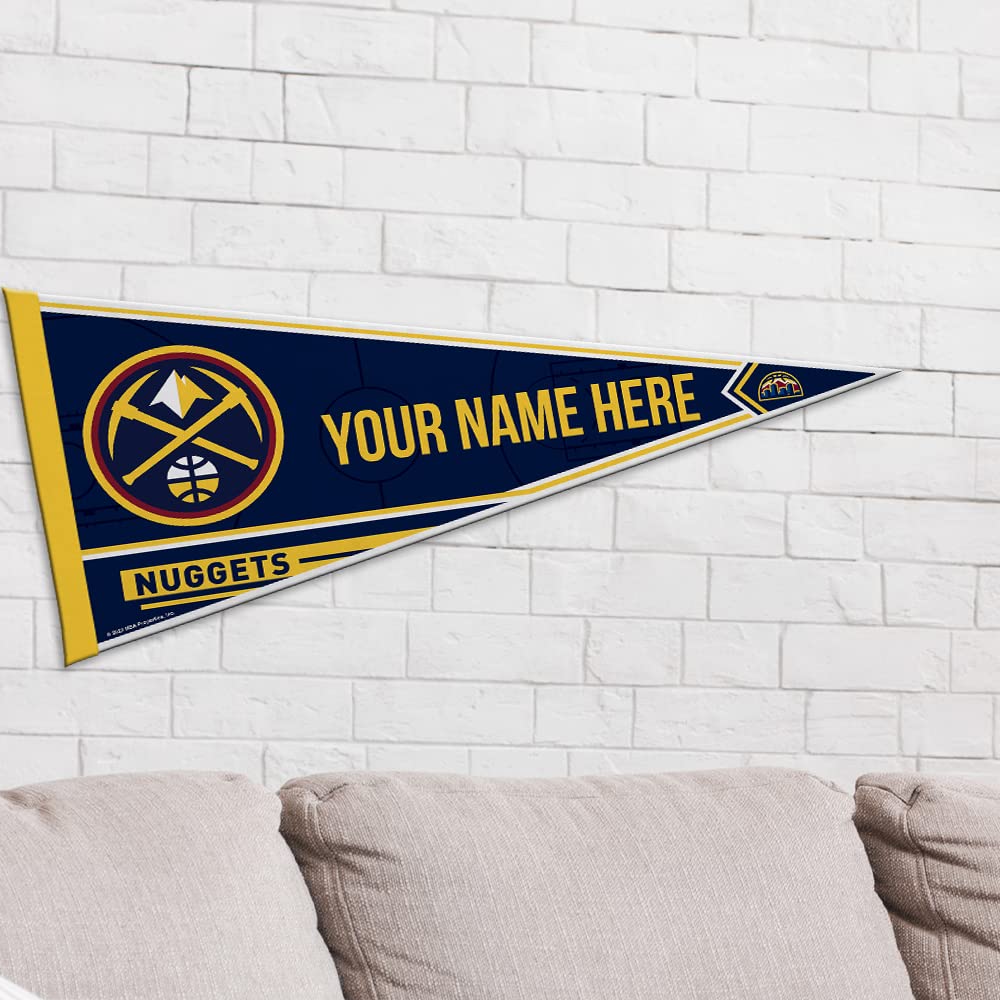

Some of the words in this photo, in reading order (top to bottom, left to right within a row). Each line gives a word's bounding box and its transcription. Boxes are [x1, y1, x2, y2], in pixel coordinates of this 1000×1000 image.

[321, 403, 447, 465] YOUR
[455, 386, 584, 449] NAME
[591, 373, 701, 433] HERE
[134, 553, 290, 596] NUGGETS
